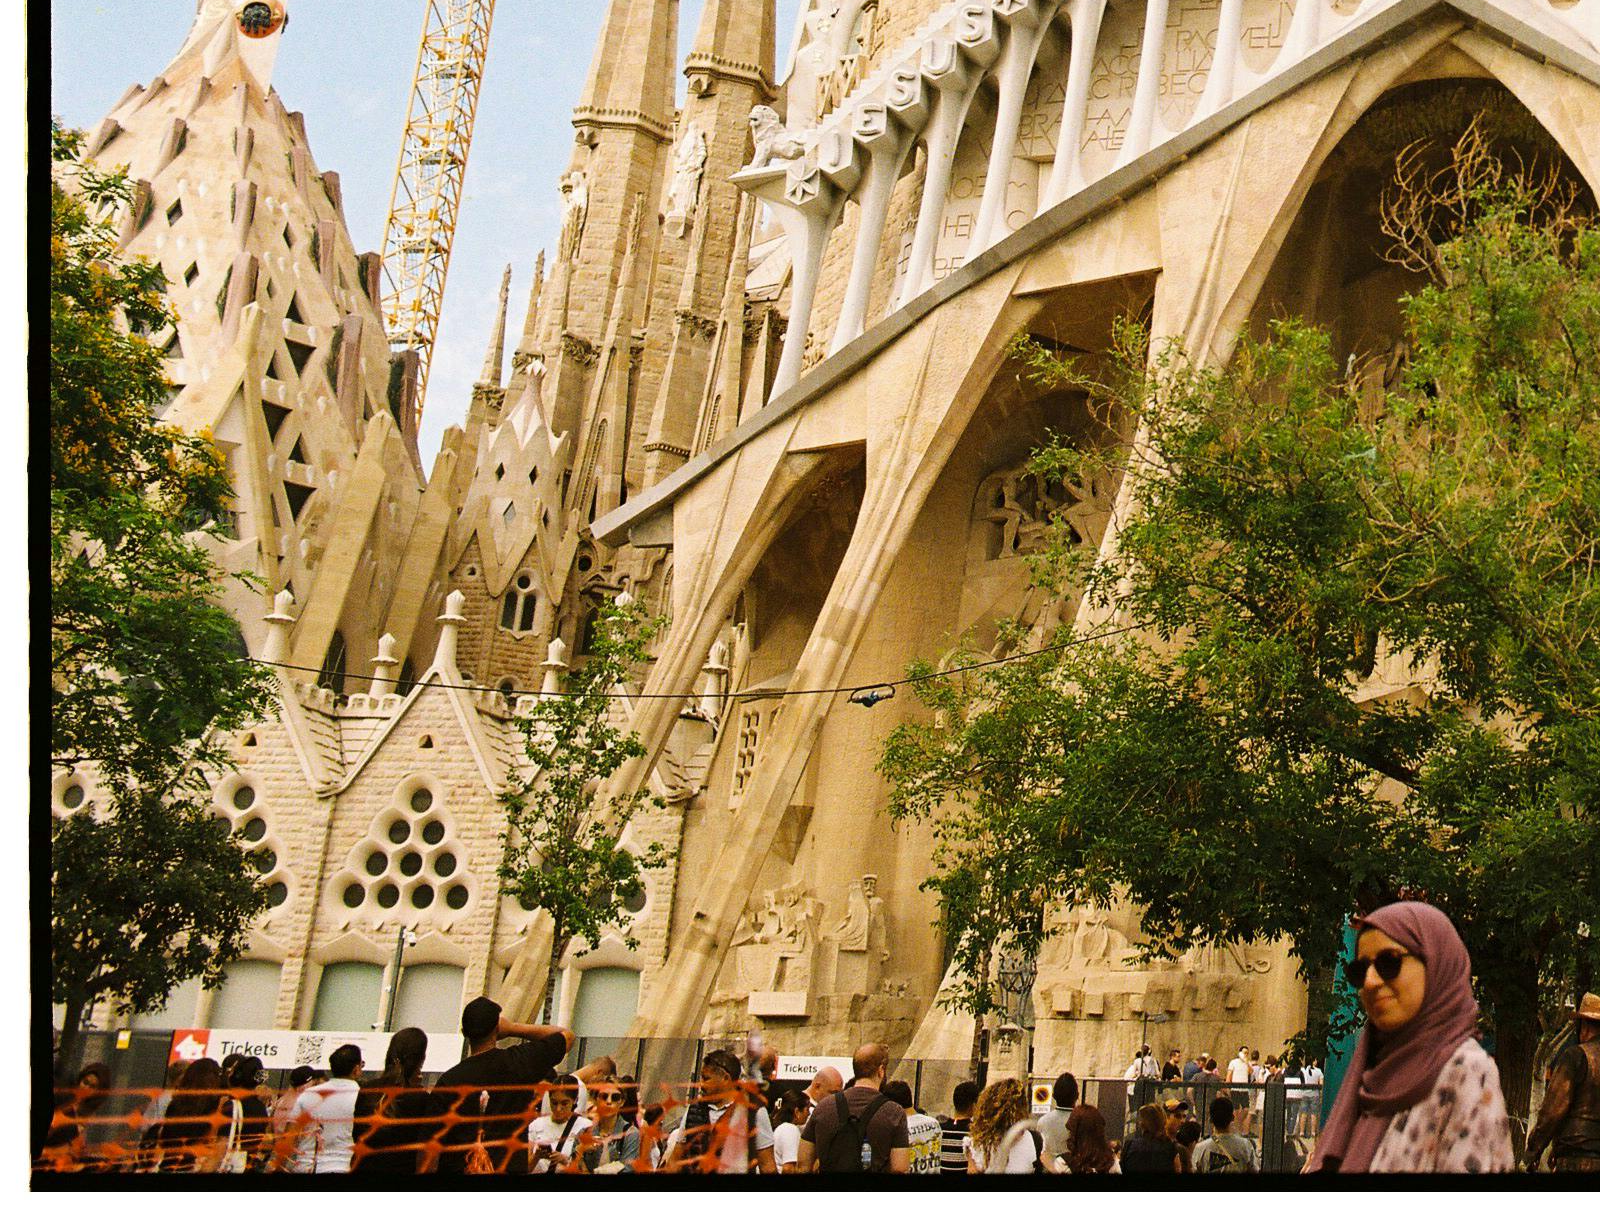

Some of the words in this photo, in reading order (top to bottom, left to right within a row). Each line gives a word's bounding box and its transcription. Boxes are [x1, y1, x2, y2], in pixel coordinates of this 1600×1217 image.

[829, 5, 988, 168] JESUS
[220, 1041, 278, 1057] Tickets
[784, 1063, 818, 1073] Tickets
